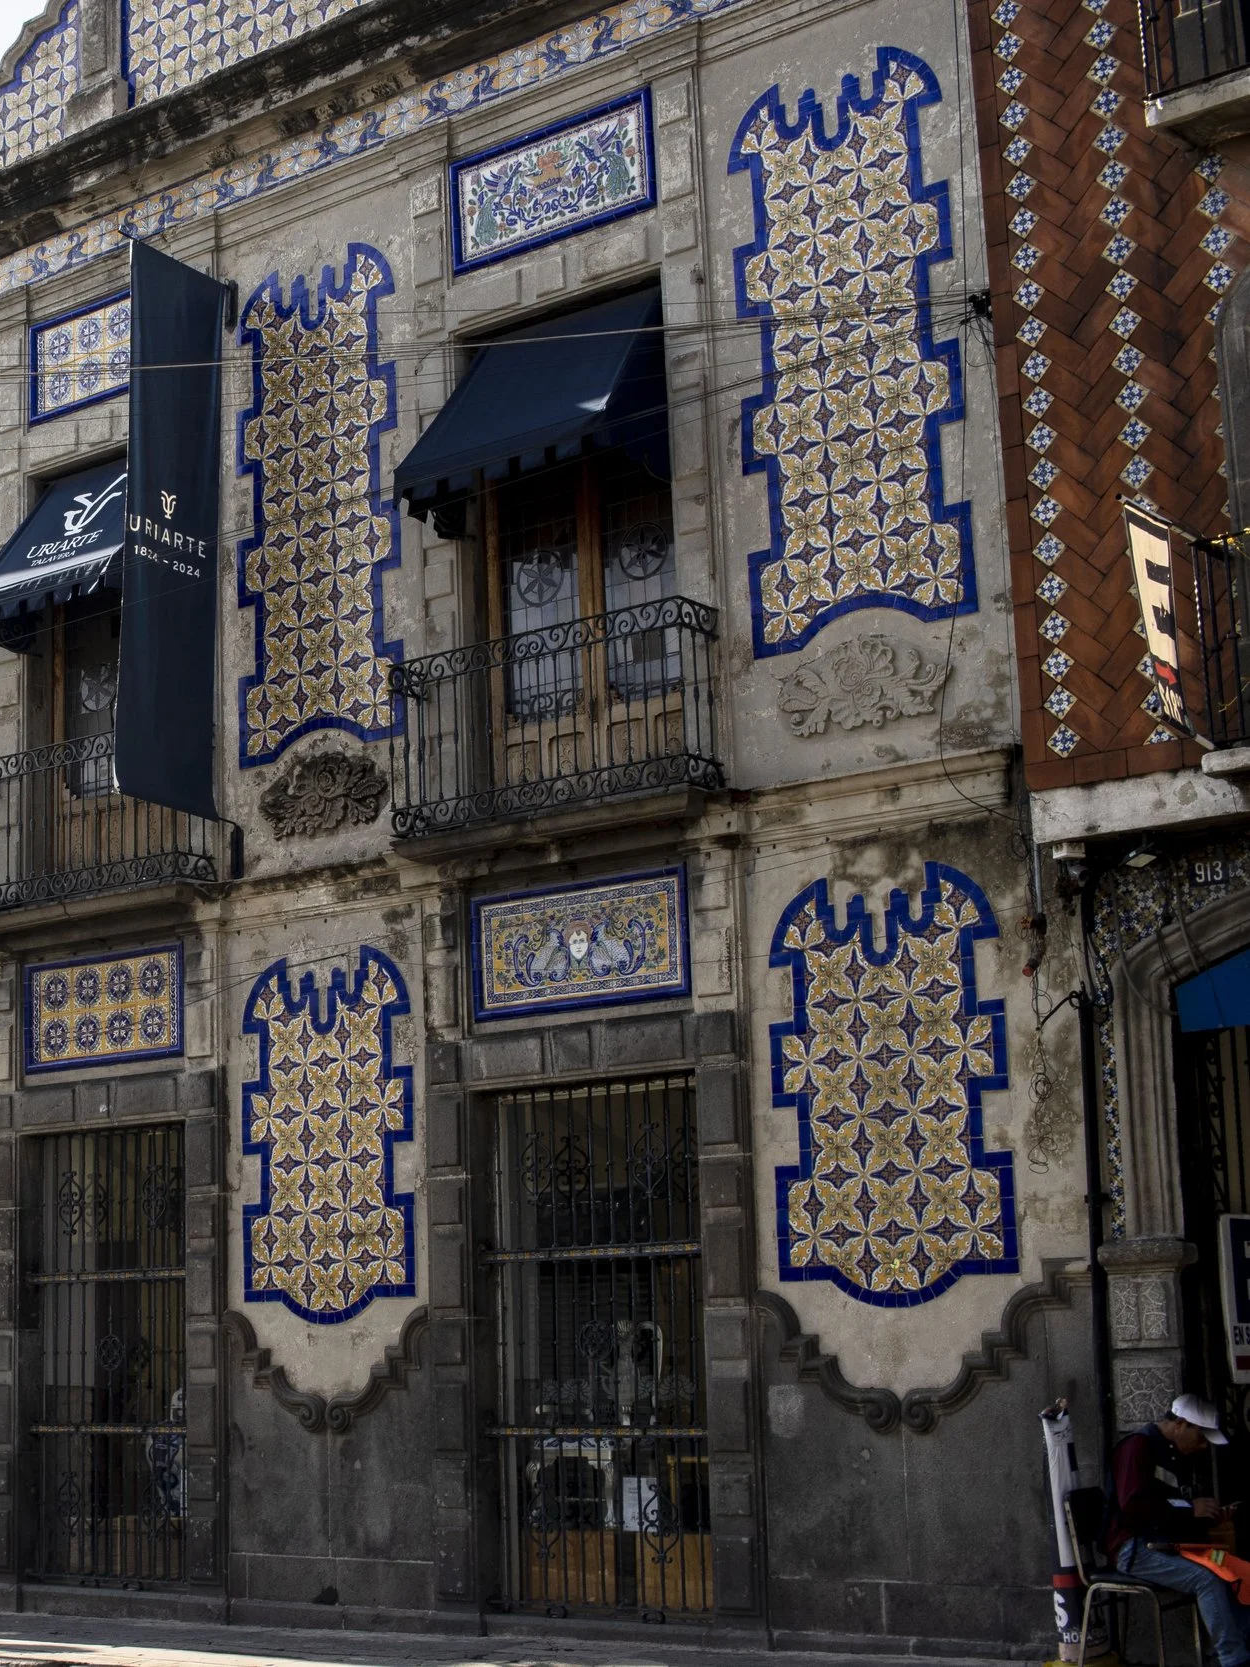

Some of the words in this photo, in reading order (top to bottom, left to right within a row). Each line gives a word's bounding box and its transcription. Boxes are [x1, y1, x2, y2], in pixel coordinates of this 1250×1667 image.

[27, 529, 103, 558] URIARTE
[130, 514, 206, 558] URIARTE
[31, 550, 76, 566] TALAVERA
[134, 545, 158, 562] 1824
[173, 561, 200, 578] 2024
[1195, 861, 1223, 882] 913
